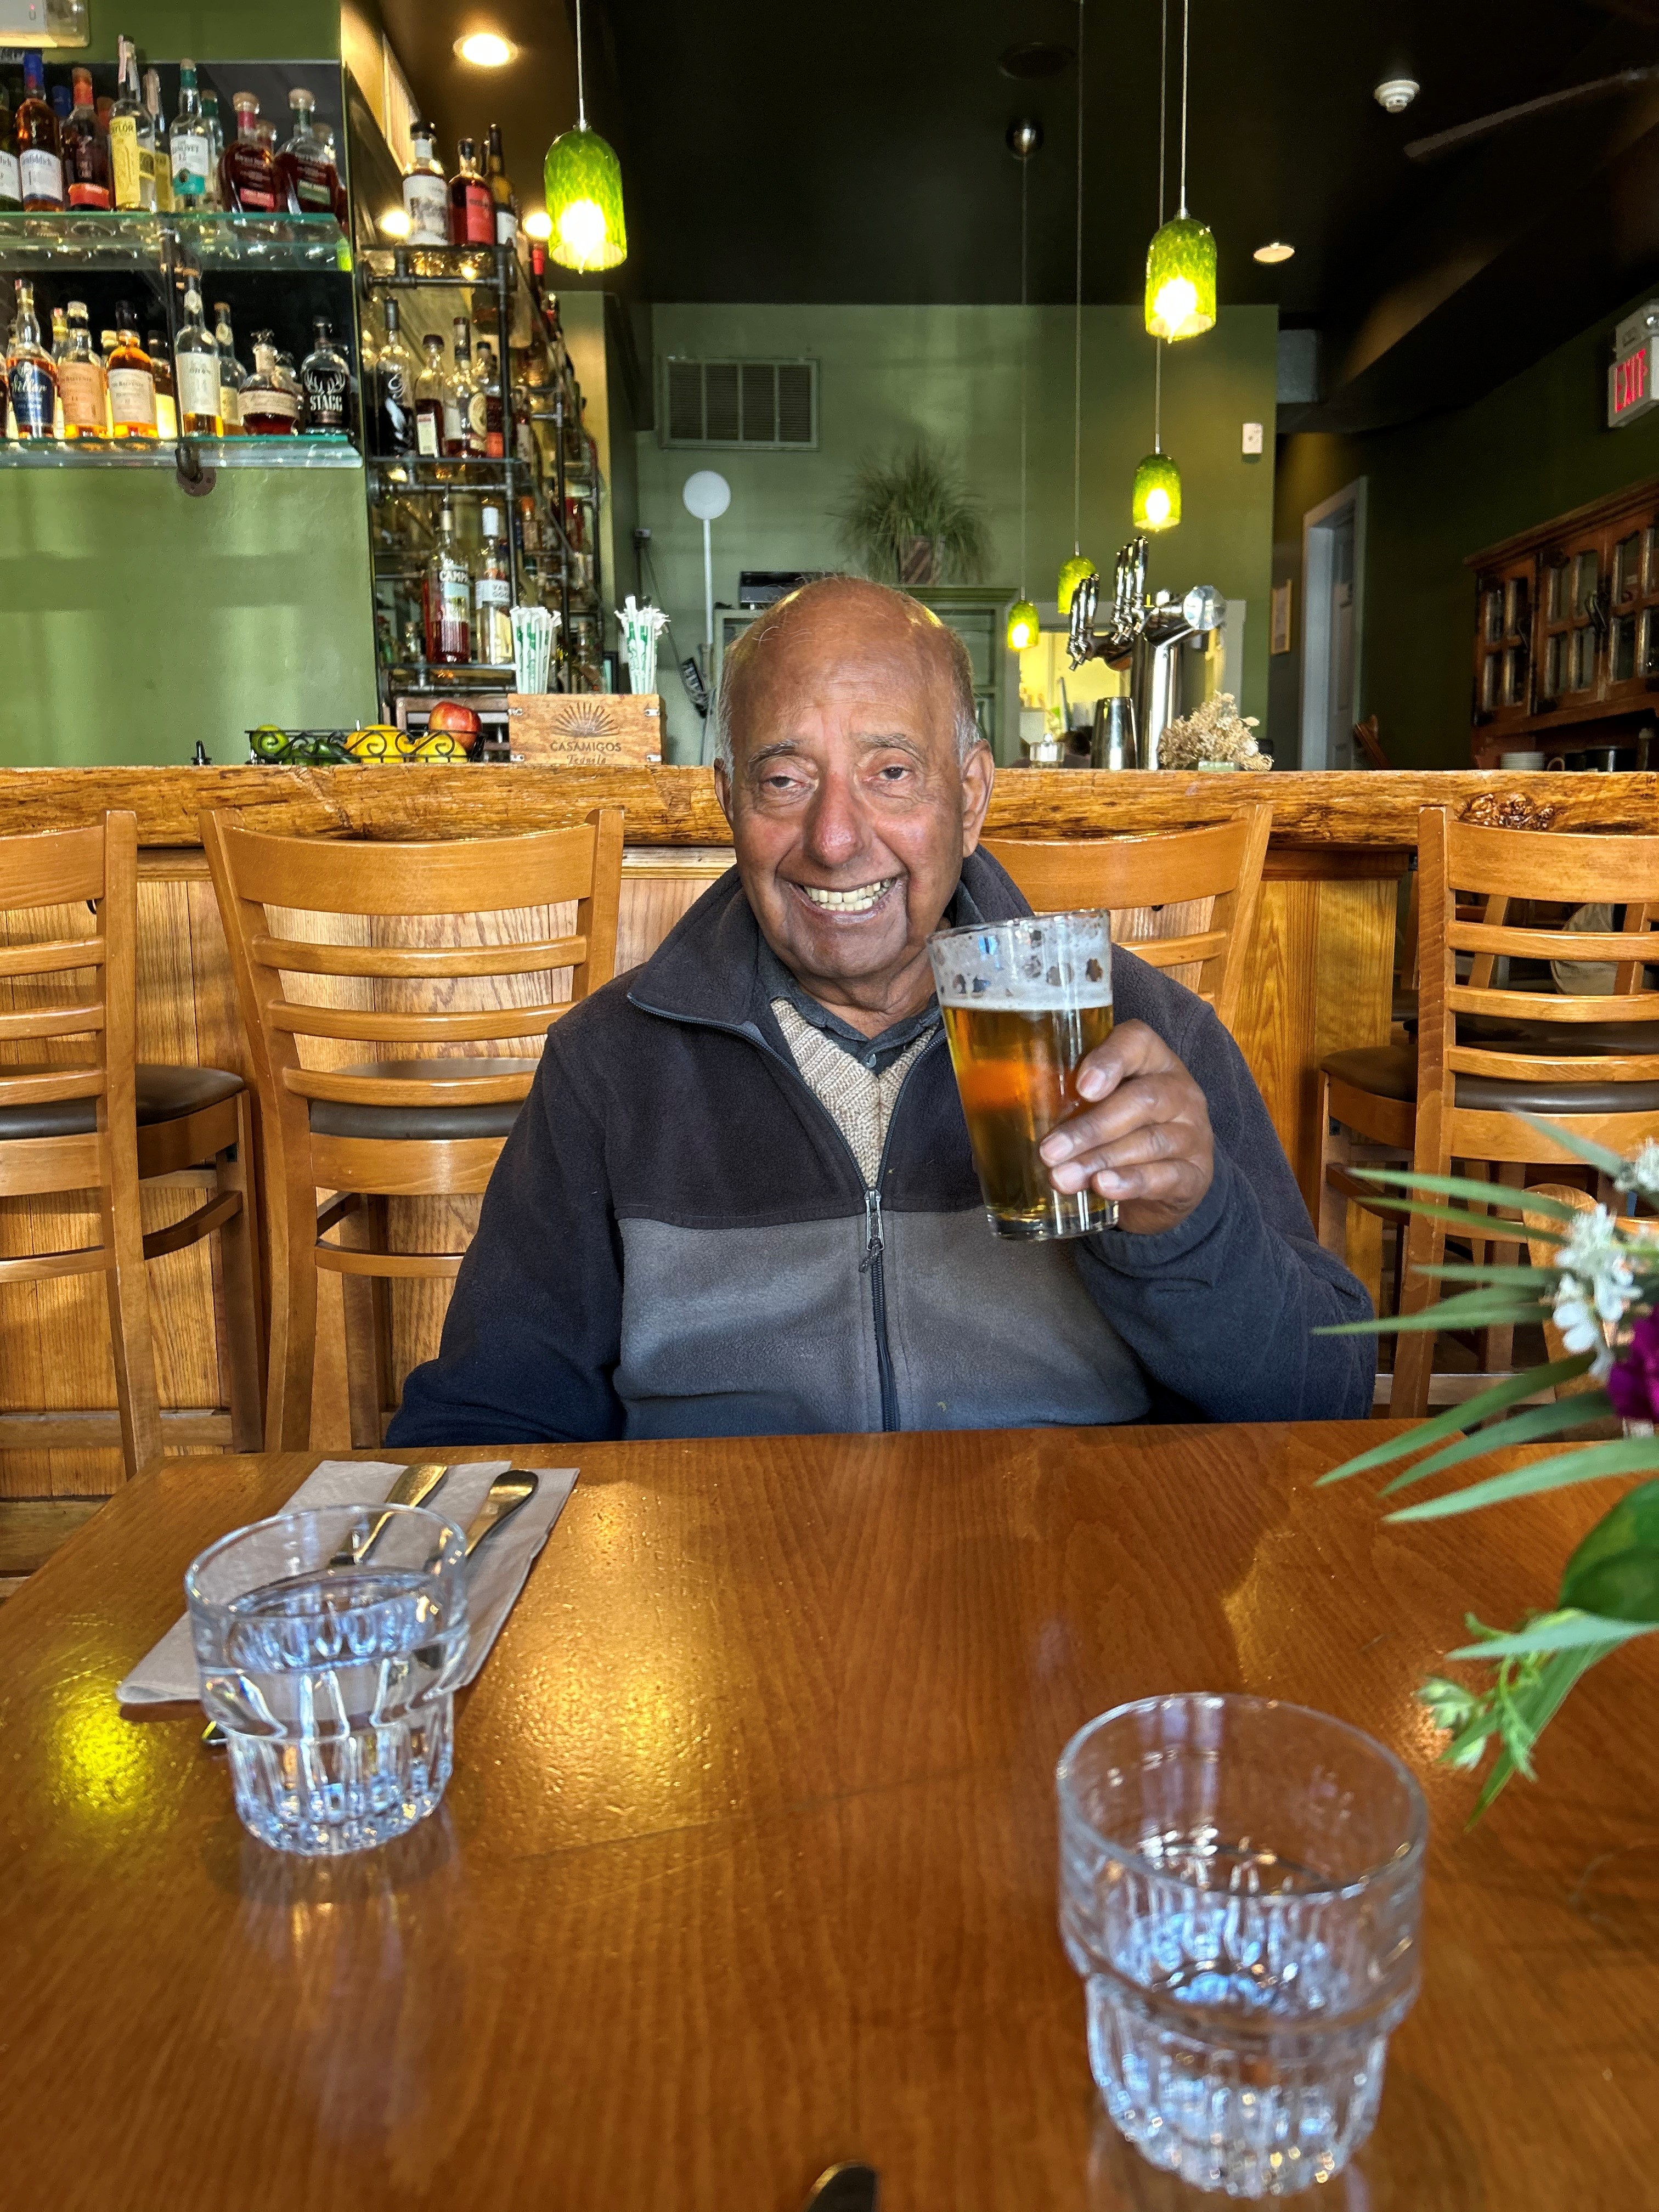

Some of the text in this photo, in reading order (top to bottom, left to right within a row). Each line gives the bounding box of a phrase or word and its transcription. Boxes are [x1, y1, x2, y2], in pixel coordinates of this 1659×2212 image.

[1615, 348, 1646, 413] EXIT
[309, 395, 343, 411] STAGG
[550, 741, 622, 752] CASAMIGOS
